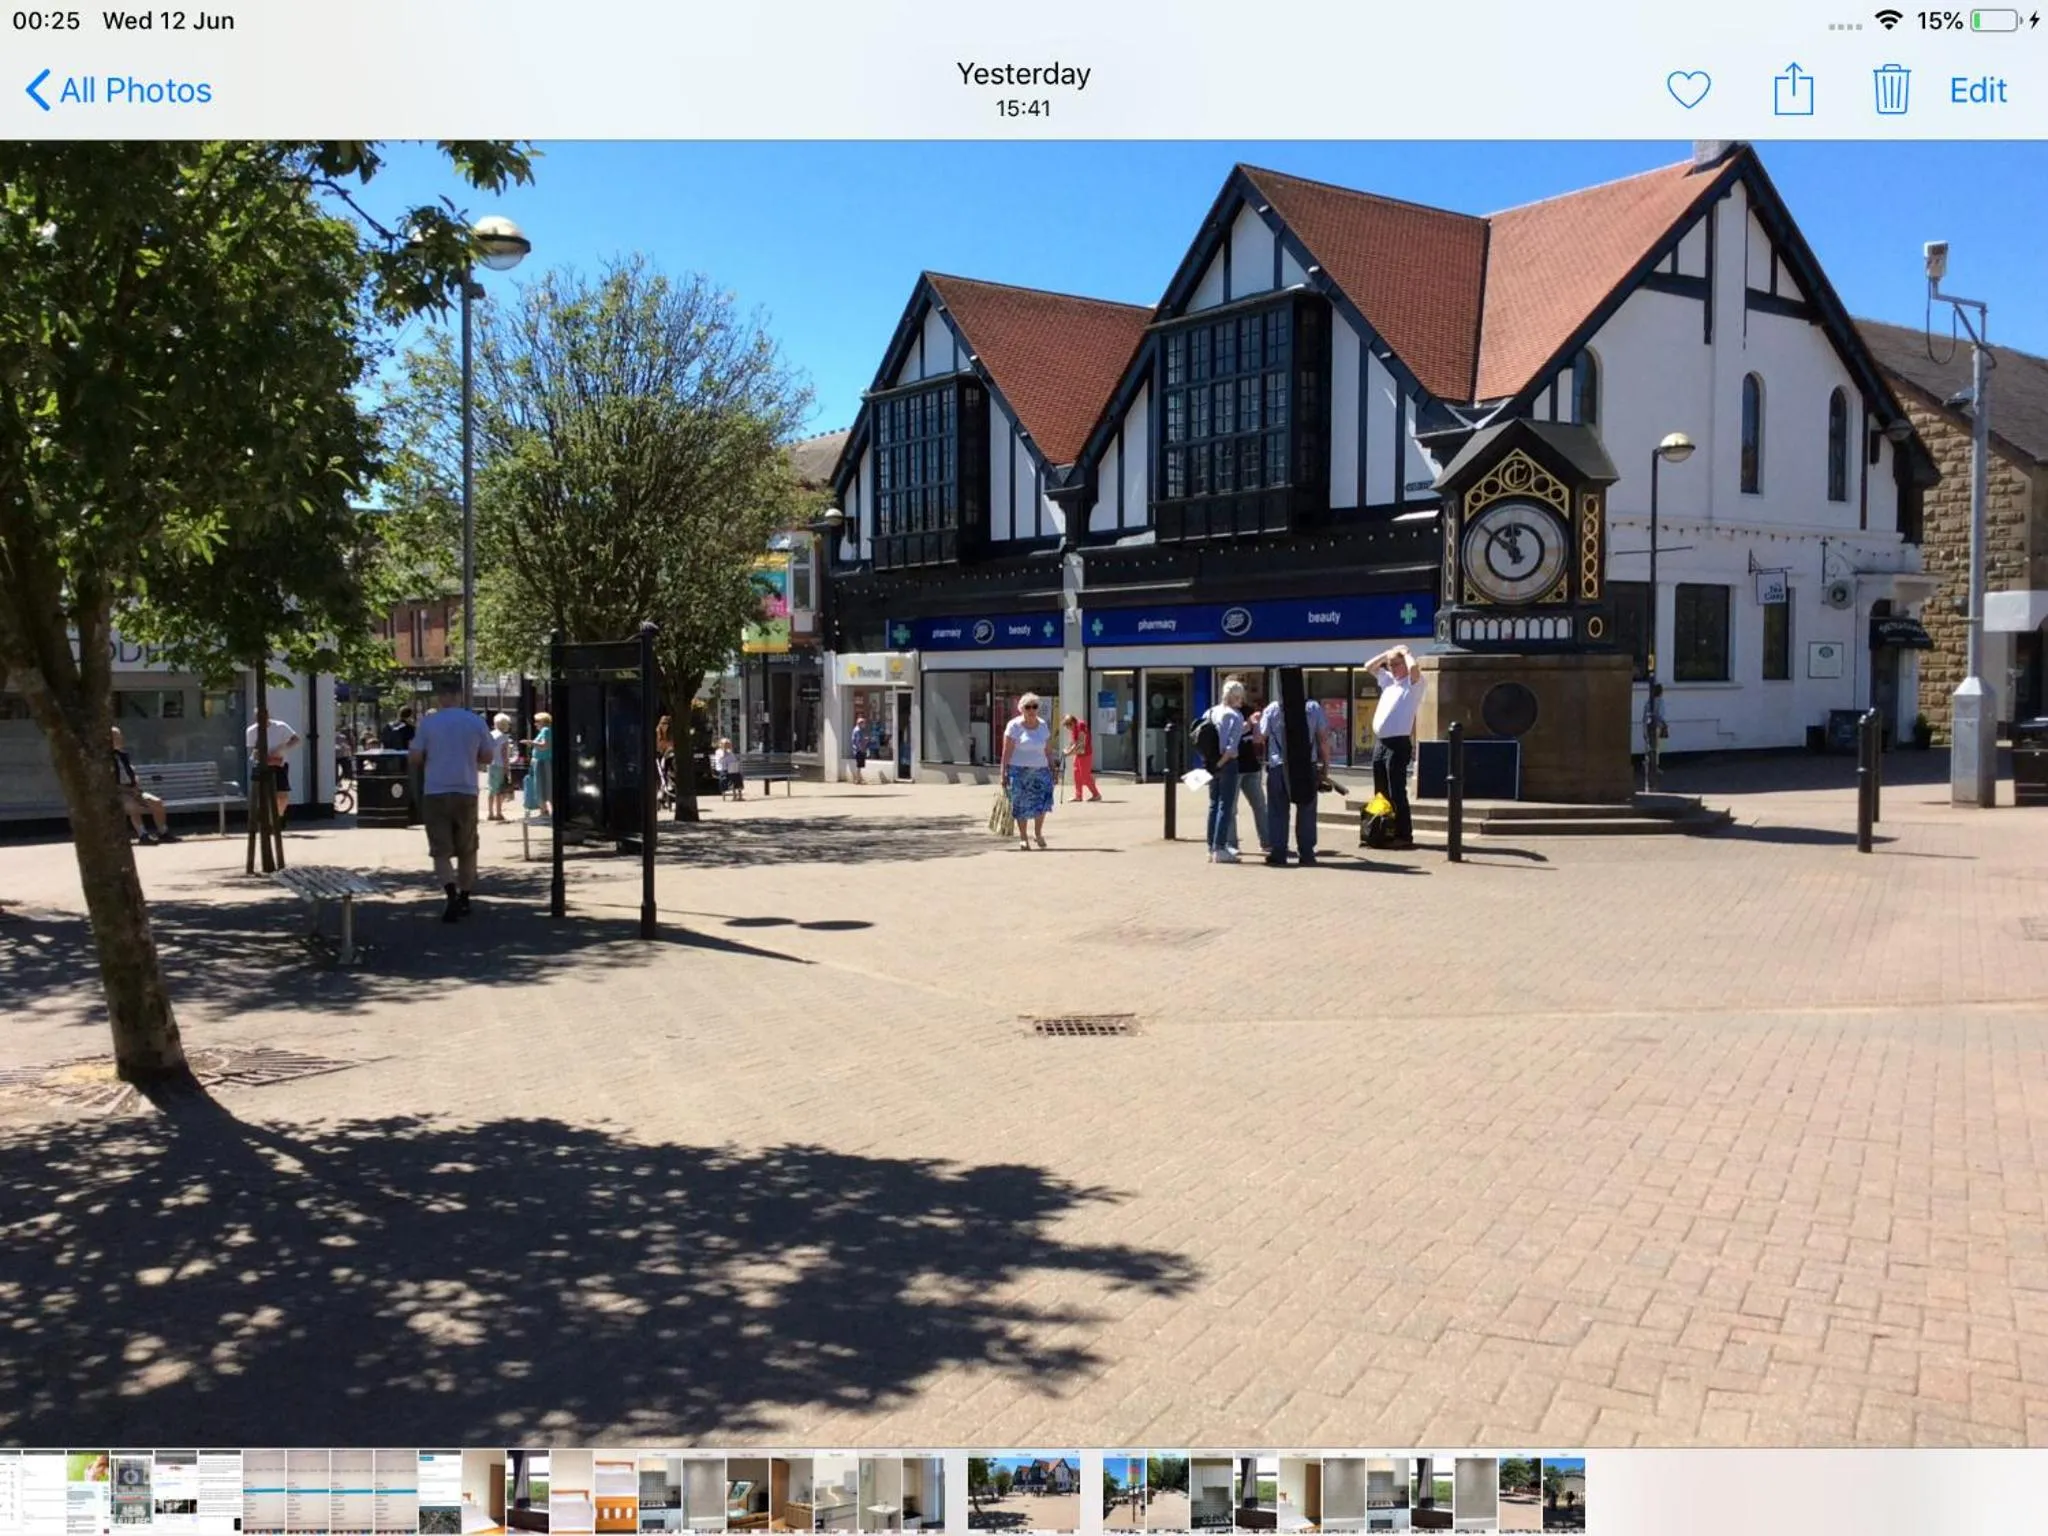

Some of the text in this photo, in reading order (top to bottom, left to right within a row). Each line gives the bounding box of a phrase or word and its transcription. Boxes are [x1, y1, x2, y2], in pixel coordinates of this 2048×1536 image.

[1137, 610, 1342, 632] pharmacy beauty
[1008, 624, 1032, 637] beauty
